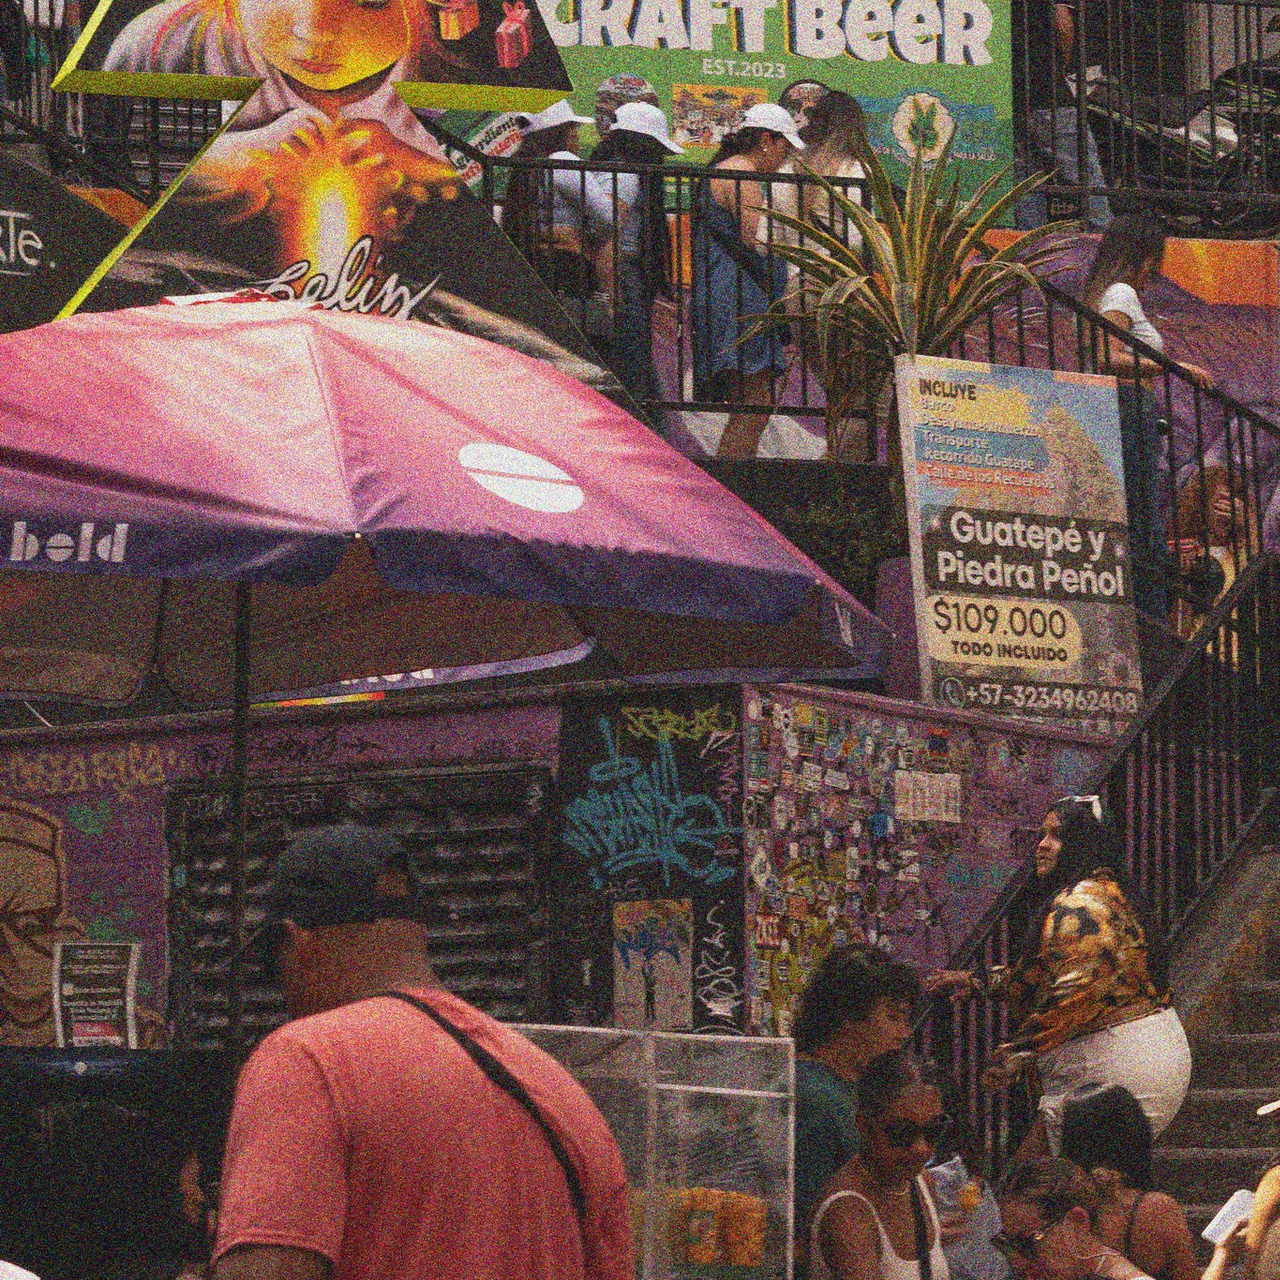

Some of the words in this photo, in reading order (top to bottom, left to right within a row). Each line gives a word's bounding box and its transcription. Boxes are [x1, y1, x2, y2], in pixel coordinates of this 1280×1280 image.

[701, 57, 786, 80] EST.2023
[919, 379, 977, 401] INCLUYE
[10, 521, 129, 563] bold
[950, 510, 1082, 558] Guatepé
[1089, 530, 1105, 561] y
[937, 549, 1035, 591] Piedra
[1042, 560, 1126, 598] Peñol
[933, 599, 1067, 641] $109.000
[952, 640, 993, 657] TODO
[997, 644, 1068, 663] INCLUIDO
